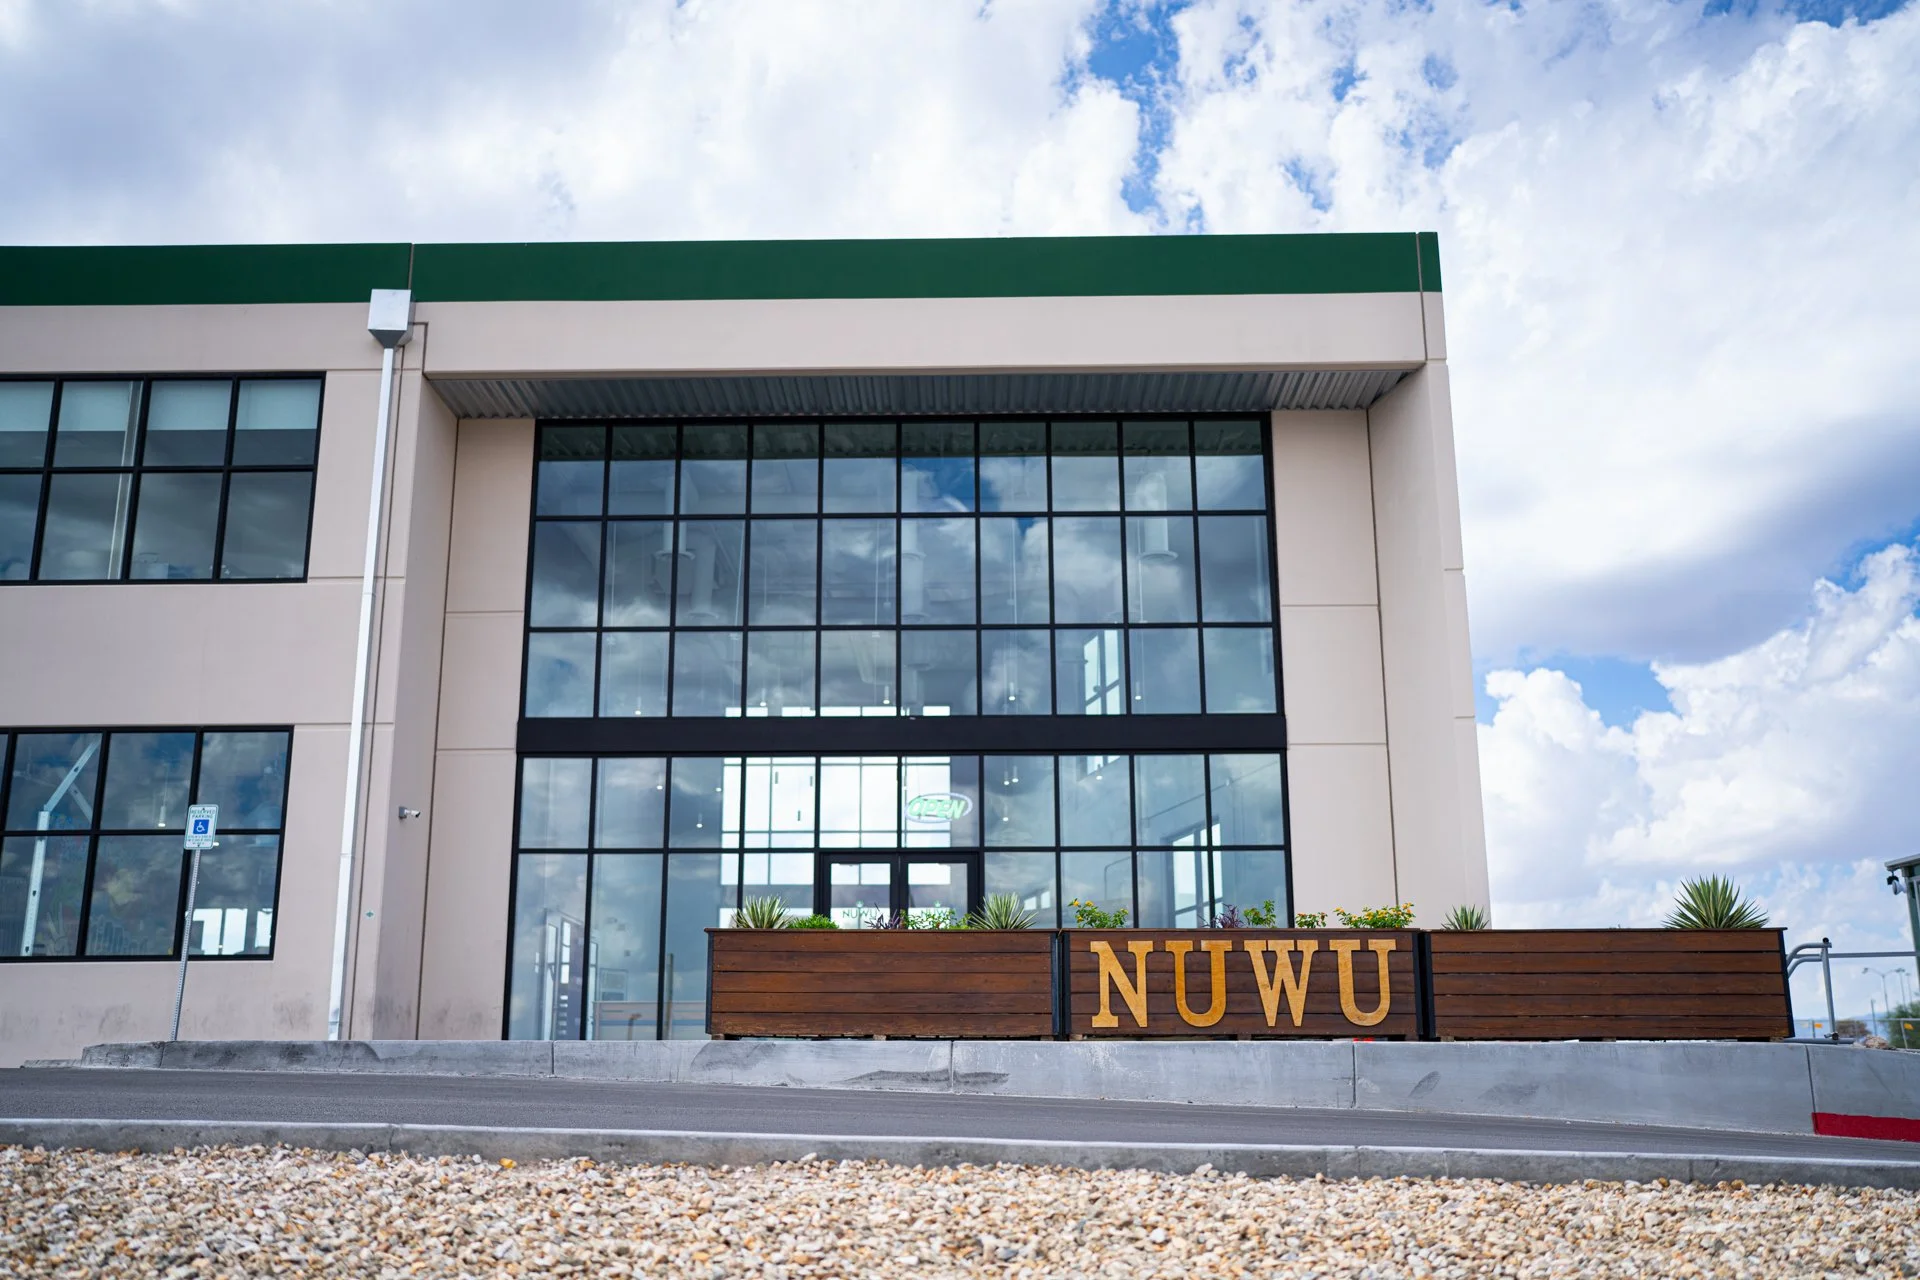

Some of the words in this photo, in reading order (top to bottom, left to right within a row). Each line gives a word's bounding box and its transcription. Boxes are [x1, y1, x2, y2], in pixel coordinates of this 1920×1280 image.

[908, 797, 966, 820] OPEN
[842, 909, 878, 919] NUWU
[1090, 939, 1397, 1028] NUWU
